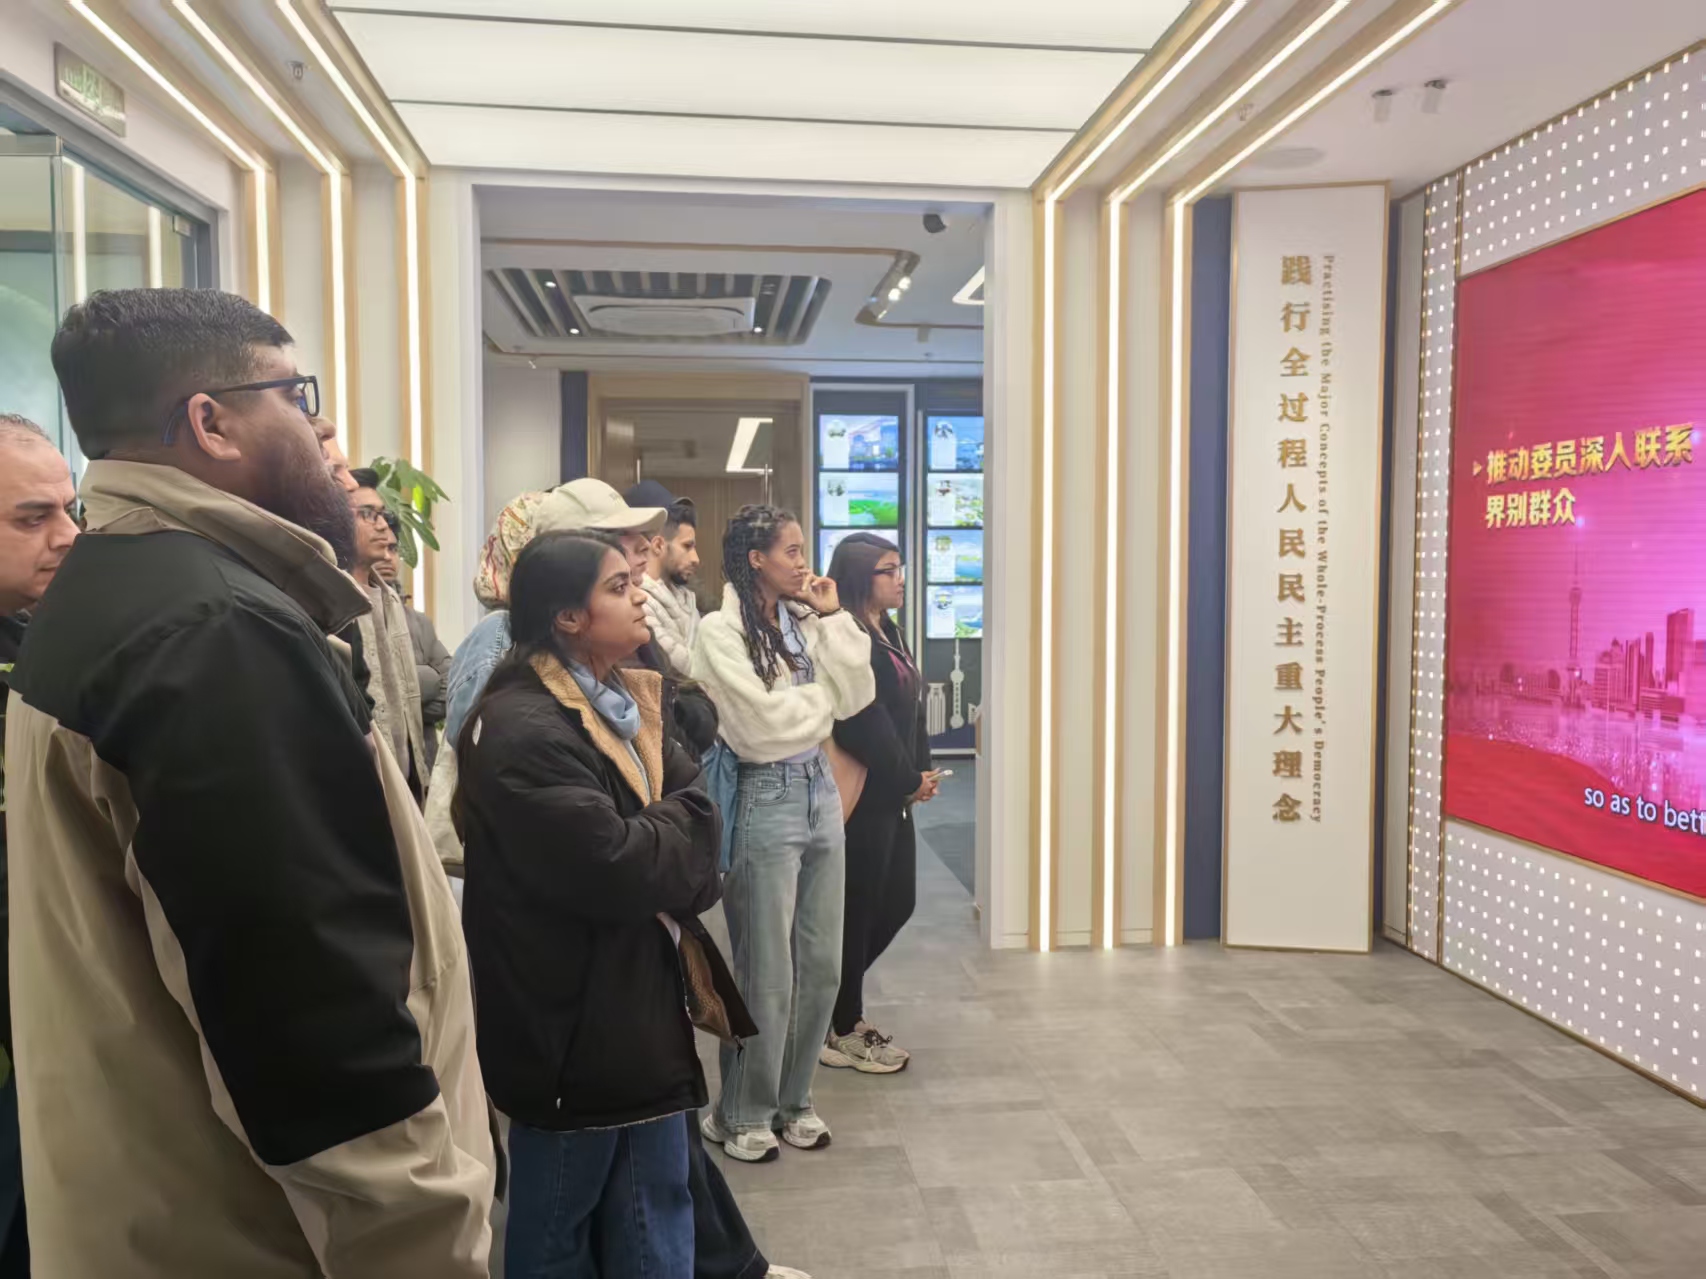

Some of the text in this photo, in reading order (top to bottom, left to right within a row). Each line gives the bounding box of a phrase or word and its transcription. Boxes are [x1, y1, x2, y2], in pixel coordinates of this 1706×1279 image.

[1320, 341, 1333, 366] the
[1317, 372, 1332, 418] Major
[1316, 423, 1331, 494] Concepts
[1317, 498, 1330, 516] of
[1485, 487, 1577, 529] 界别群众
[1273, 255, 1312, 823] 践行全过程人民民主重大理念
[1316, 520, 1329, 544] the
[1315, 550, 1328, 663] Whole-Process
[1309, 740, 1324, 823] Democracy
[1584, 787, 1605, 808] so
[1610, 793, 1631, 815] as
[1636, 795, 1657, 822] to
